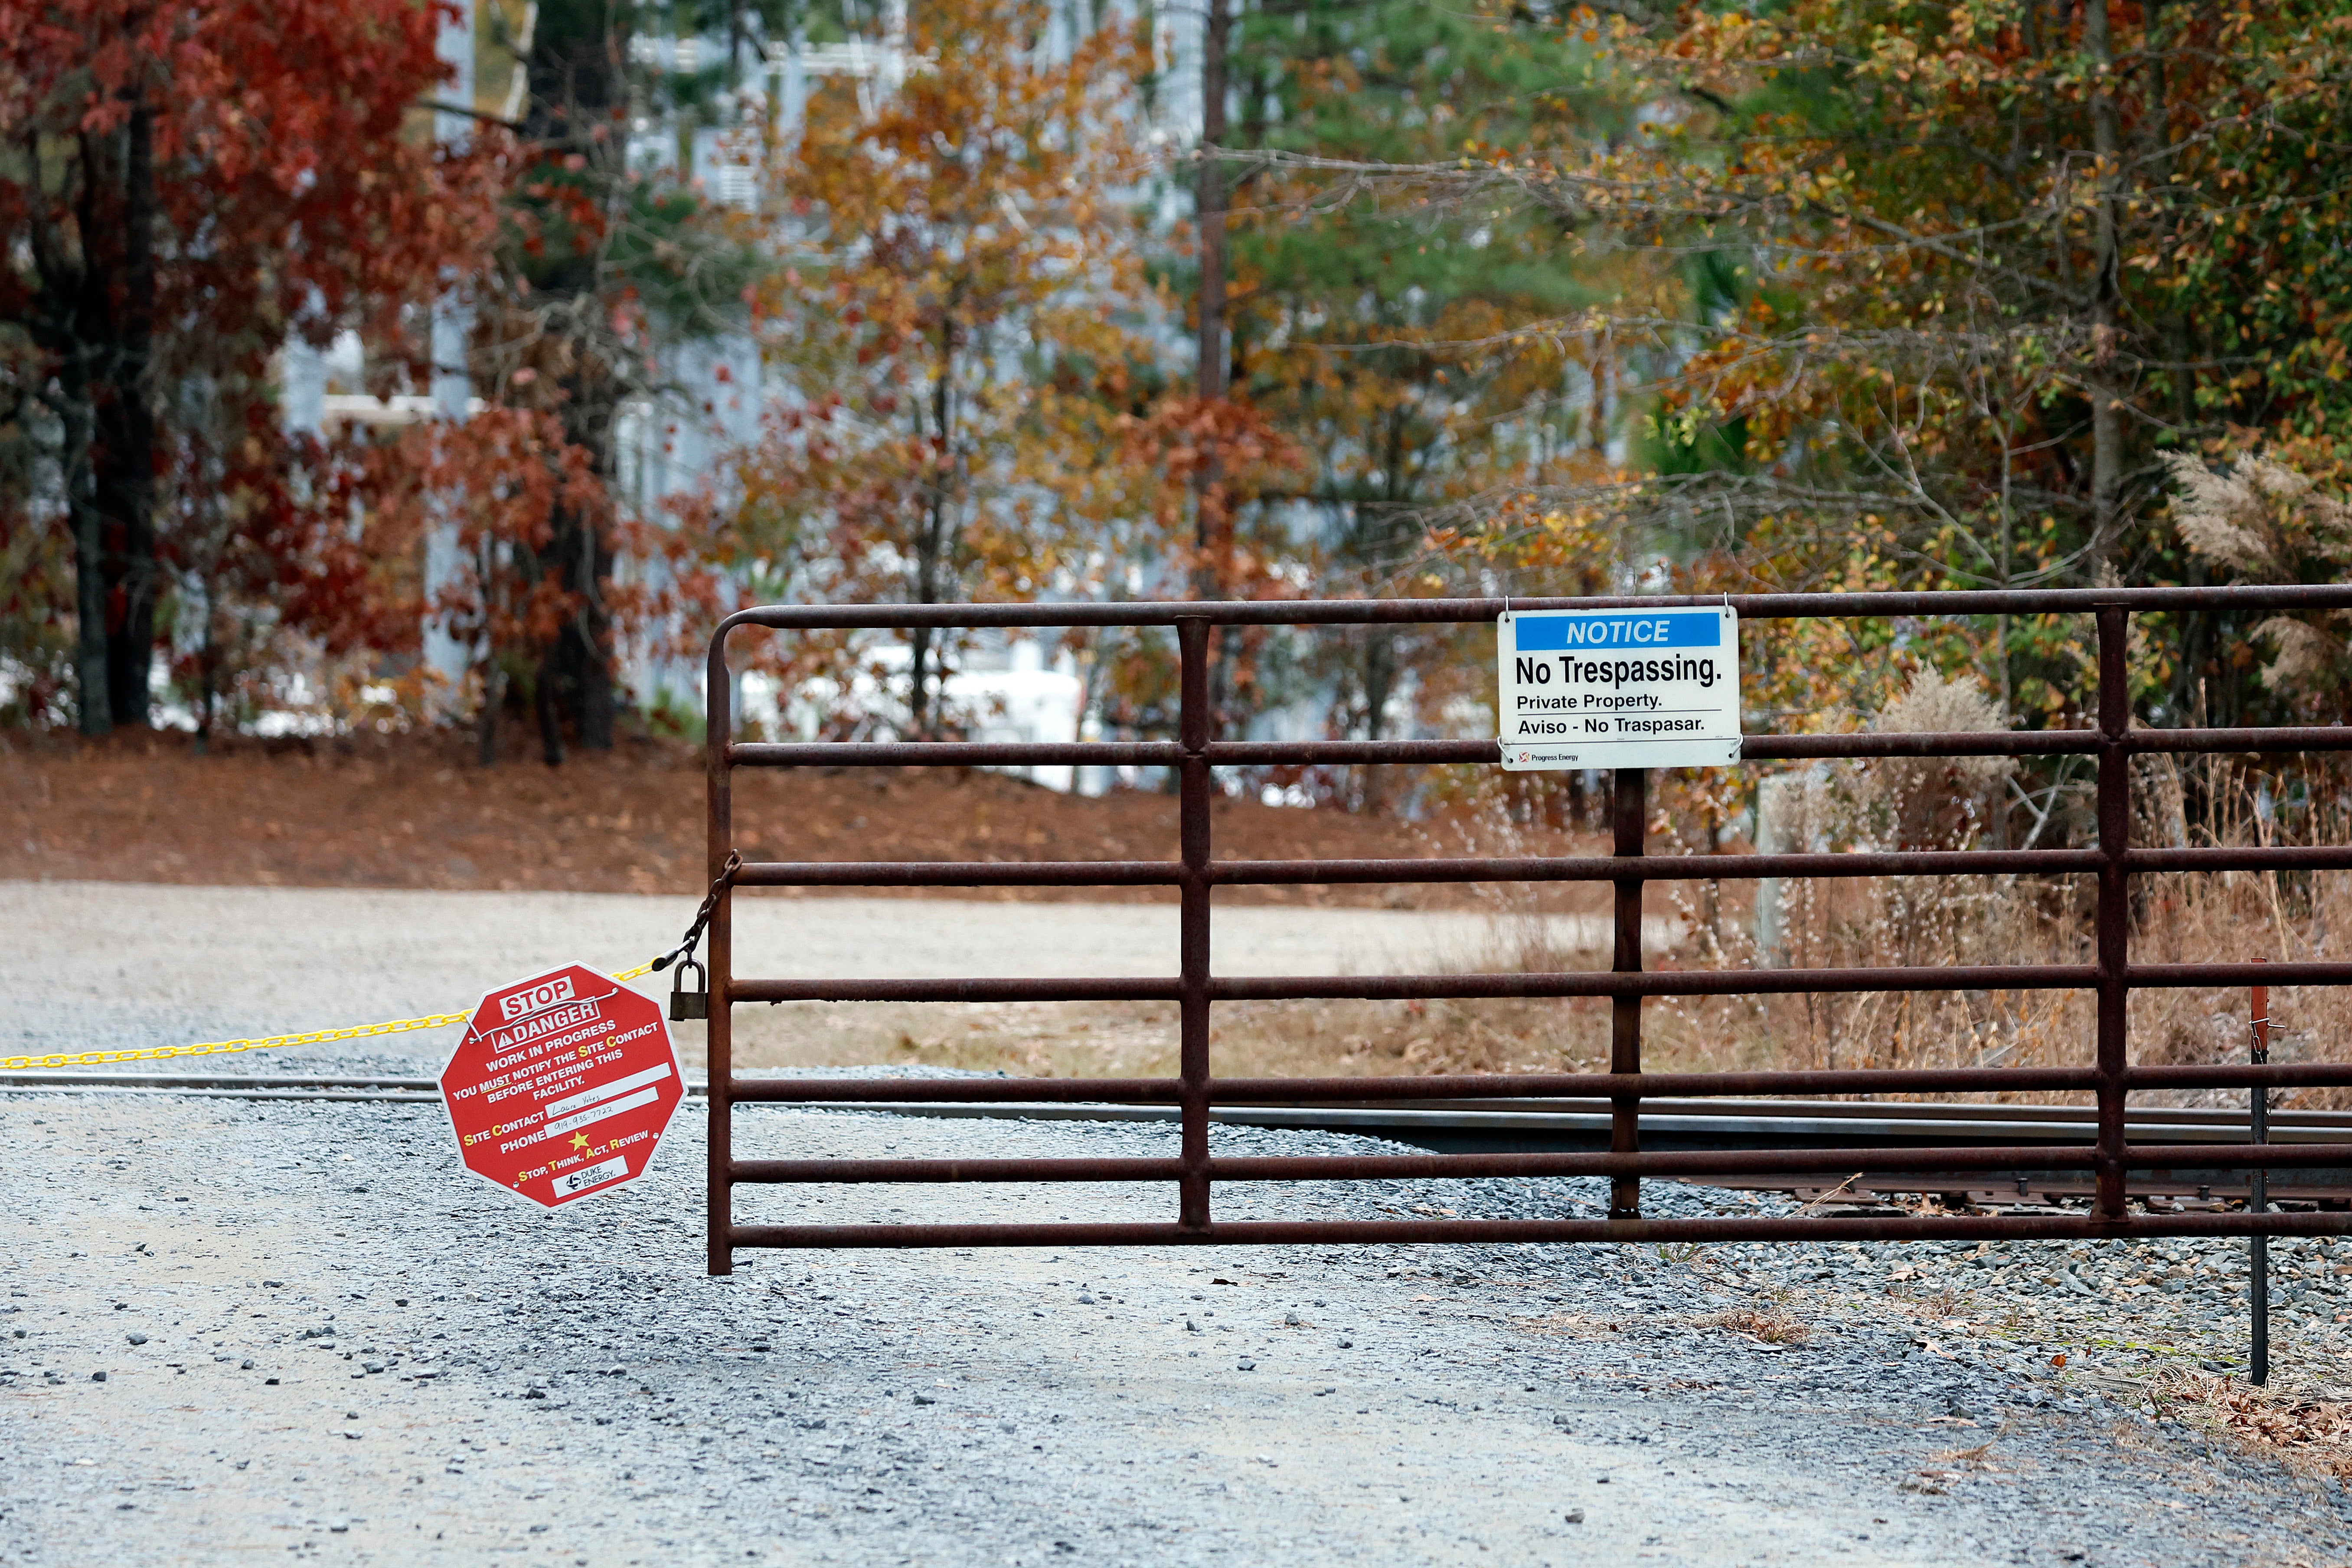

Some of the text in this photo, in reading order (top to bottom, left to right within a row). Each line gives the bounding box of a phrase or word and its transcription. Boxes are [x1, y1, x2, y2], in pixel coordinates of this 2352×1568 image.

[1567, 621, 1670, 644] NOTICE
[1516, 653, 1722, 689] No Trespassing.
[1518, 694, 1663, 710] Private Property.
[1519, 720, 1567, 734] Aviso
[1585, 719, 1609, 733] No
[1615, 718, 1705, 735] Traspasar.
[506, 981, 568, 1015] STOP
[513, 1003, 595, 1042] DANGER
[453, 1022, 658, 1101] YOU MUST NOTIFY THE SITE CONTACT
[486, 1020, 616, 1072] WORK IN PROGRESS
[487, 1049, 623, 1103] BEFORE ENTERING THIS
[532, 1076, 585, 1101] FACILITY.
[464, 1112, 545, 1147] SITE CONTACT
[555, 1107, 613, 1130] 919-935-7722
[500, 1131, 546, 1154] PHONE
[519, 1130, 649, 1182] STOP, THINK, ACT, REVIEW
[581, 1166, 602, 1179] DUKE
